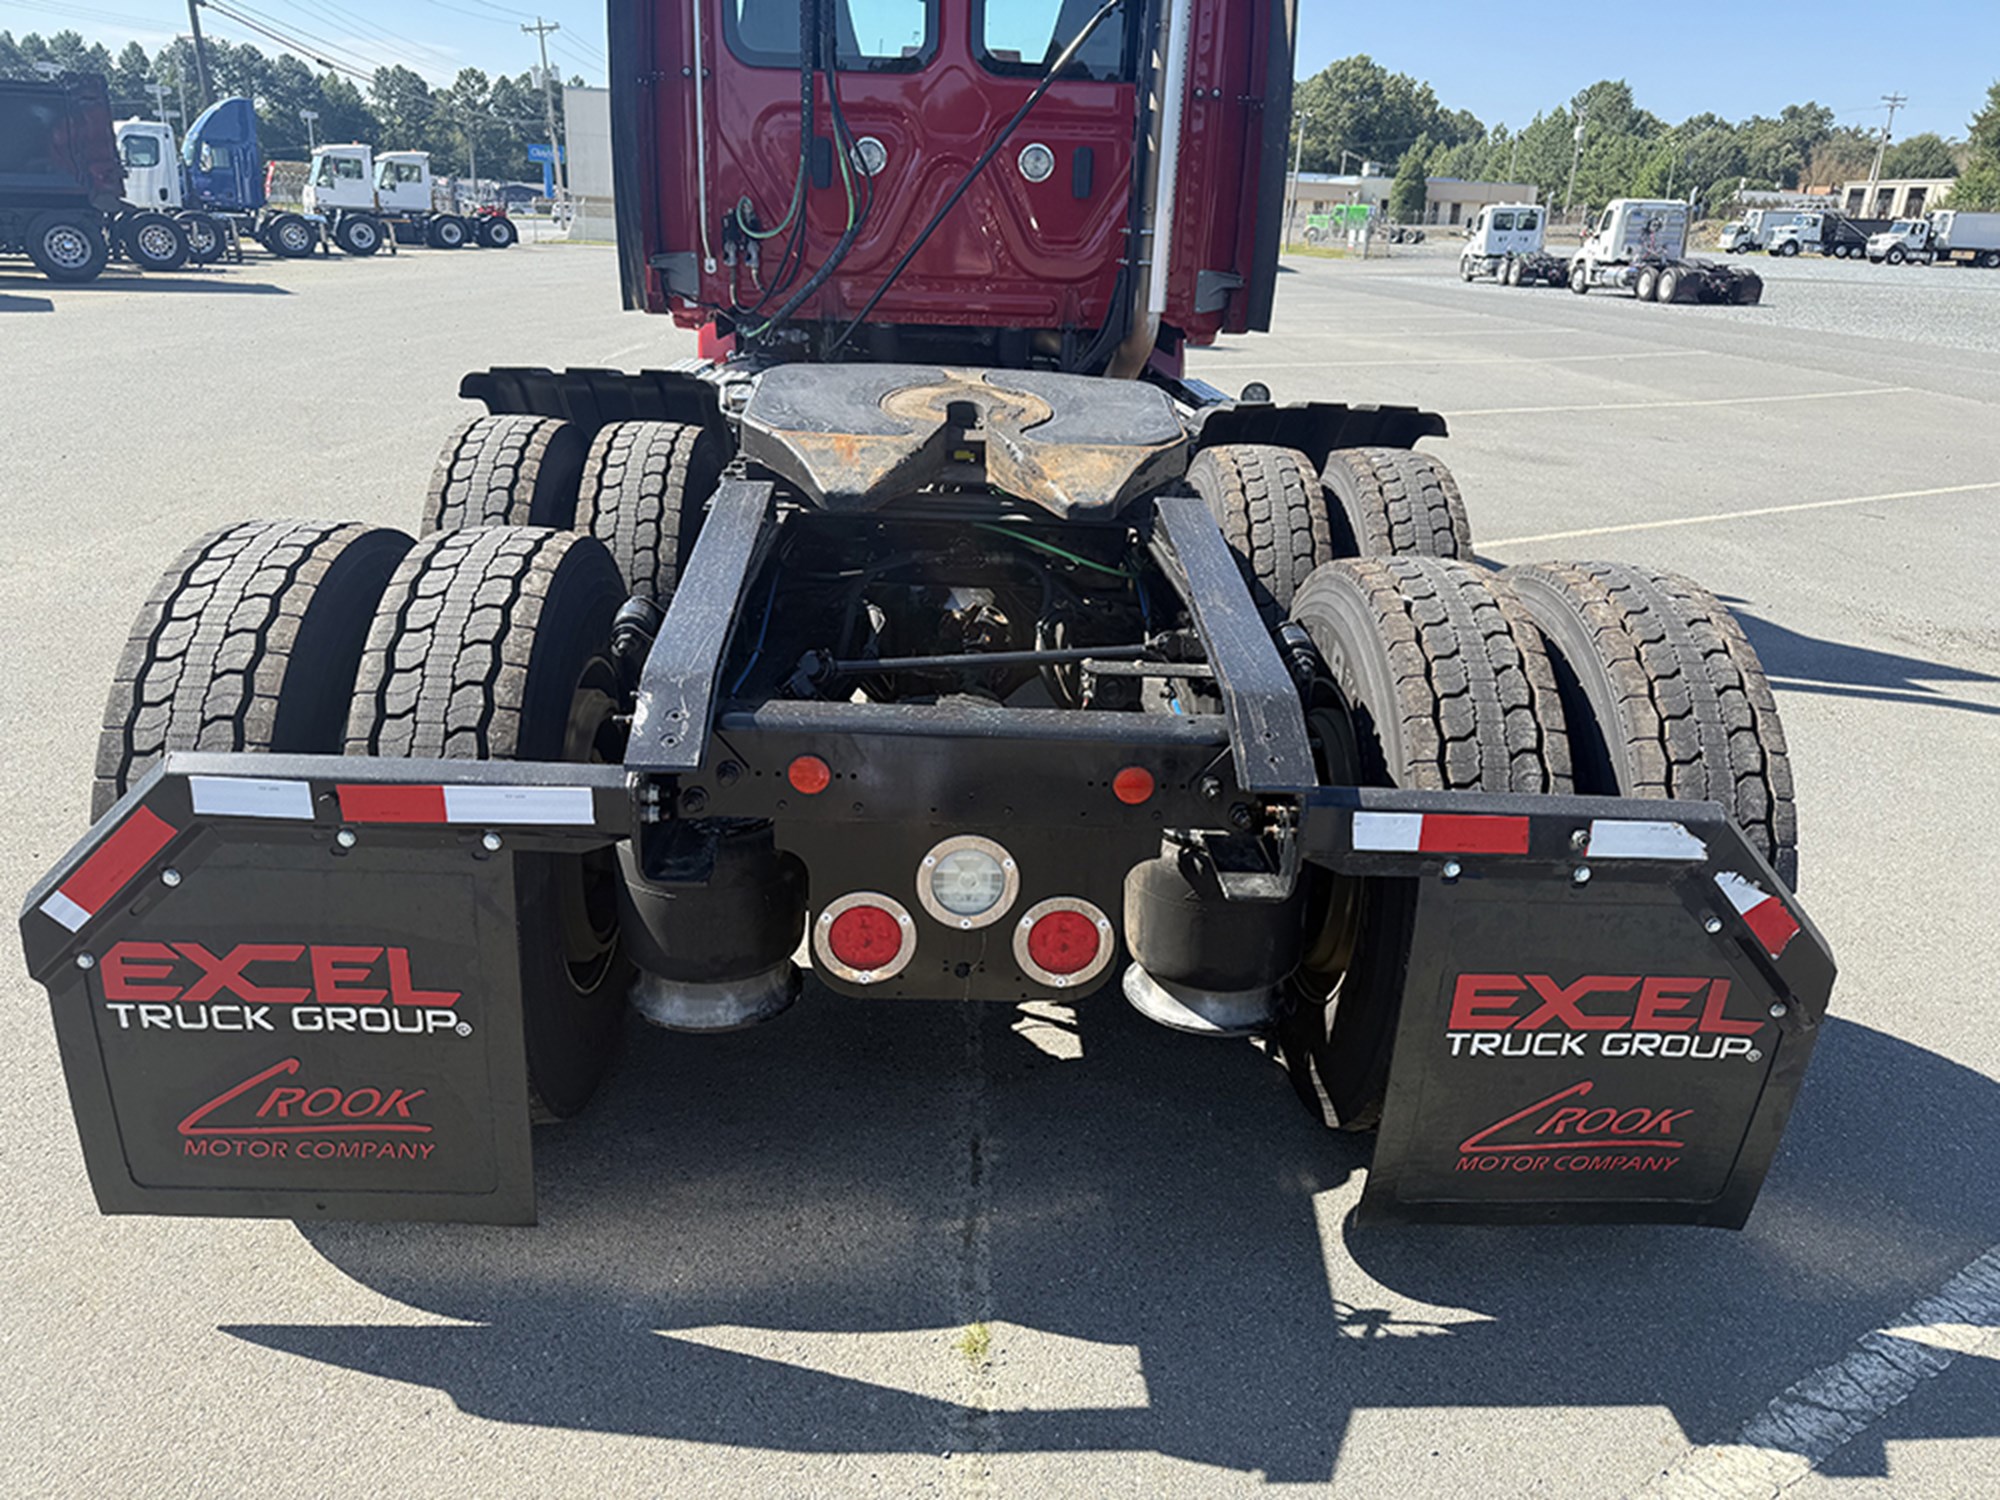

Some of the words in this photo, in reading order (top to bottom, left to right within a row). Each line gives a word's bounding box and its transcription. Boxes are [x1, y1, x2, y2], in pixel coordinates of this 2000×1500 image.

[100, 941, 461, 1007] EXCEL
[106, 1003, 275, 1032] TRUCK
[1449, 974, 1765, 1034] EXCEL
[1446, 1032, 1587, 1058] TRUCK
[184, 1139, 288, 1158] MOTOR
[296, 1141, 436, 1160] COMPANY
[1455, 1155, 1550, 1172] MOTOR
[1554, 1154, 1680, 1172] COMPANY
